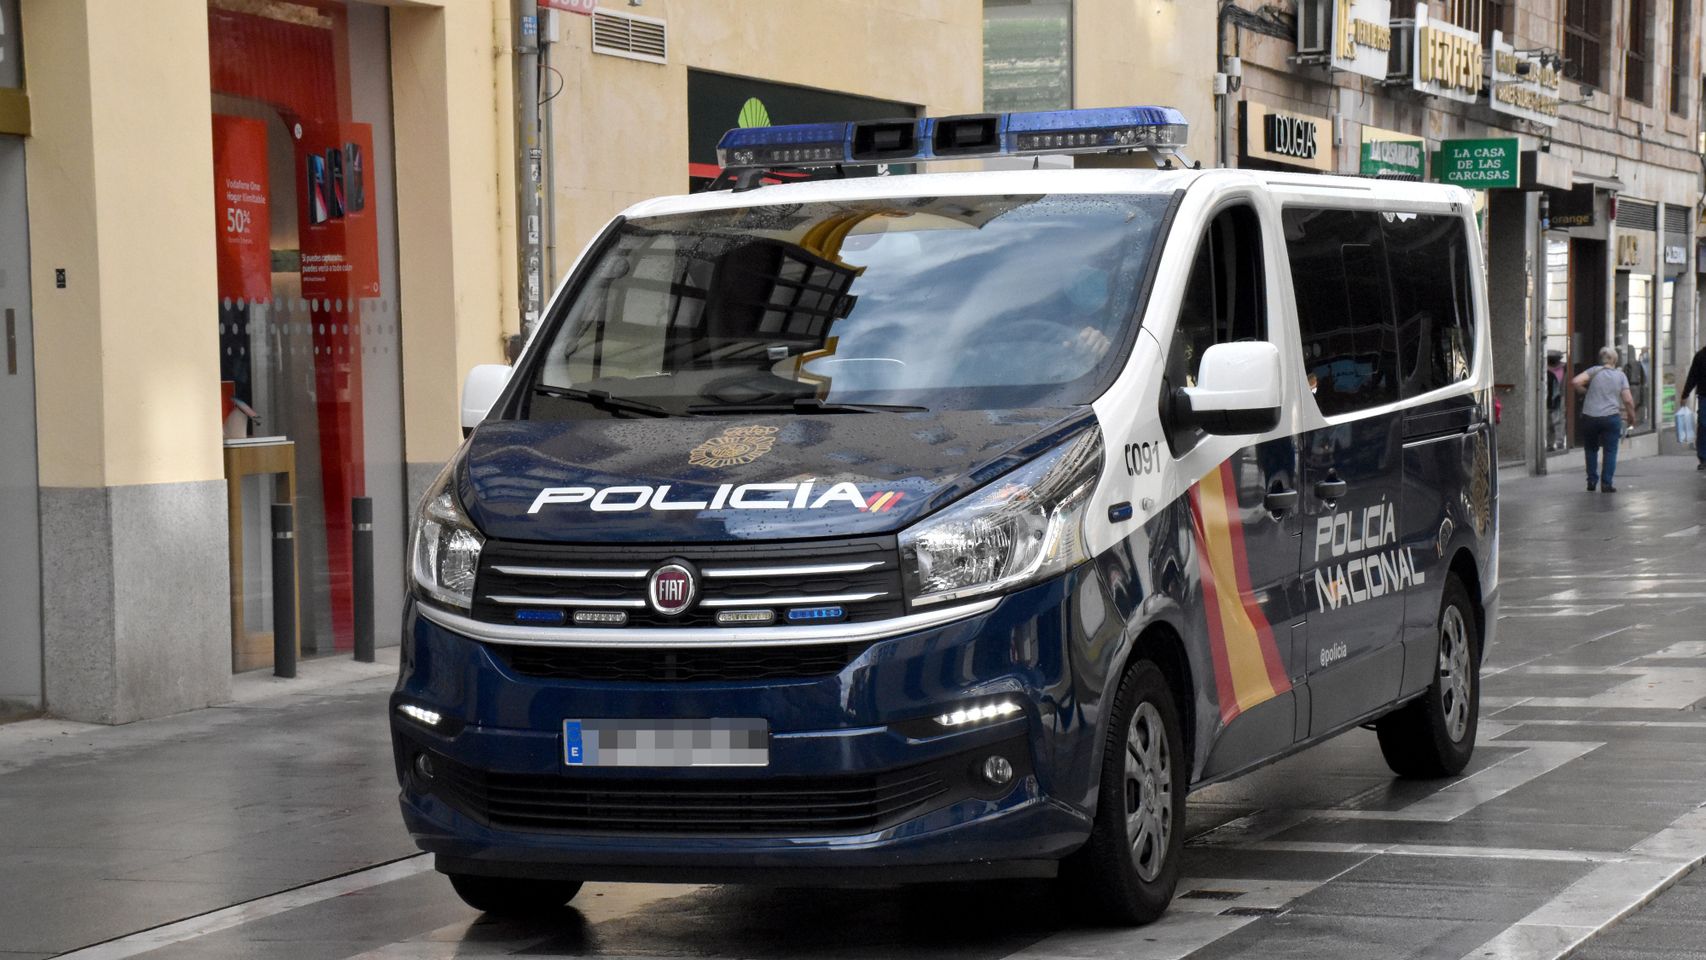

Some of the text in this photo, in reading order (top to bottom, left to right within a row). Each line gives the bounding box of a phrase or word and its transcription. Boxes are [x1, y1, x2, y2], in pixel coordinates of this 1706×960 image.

[1274, 113, 1317, 159] DOUGLAS
[1453, 148, 1506, 158] LA CASA
[1448, 170, 1510, 180] CARCASAS
[1457, 159, 1501, 170] DE LAS
[1552, 214, 1590, 225] orange
[1125, 440, 1160, 476] C091
[527, 478, 868, 514] POLICÍA
[1314, 493, 1396, 562] POLICÍA
[659, 579, 685, 601] FIAT
[1315, 546, 1425, 613] NACIONAL
[571, 747, 579, 757] E
